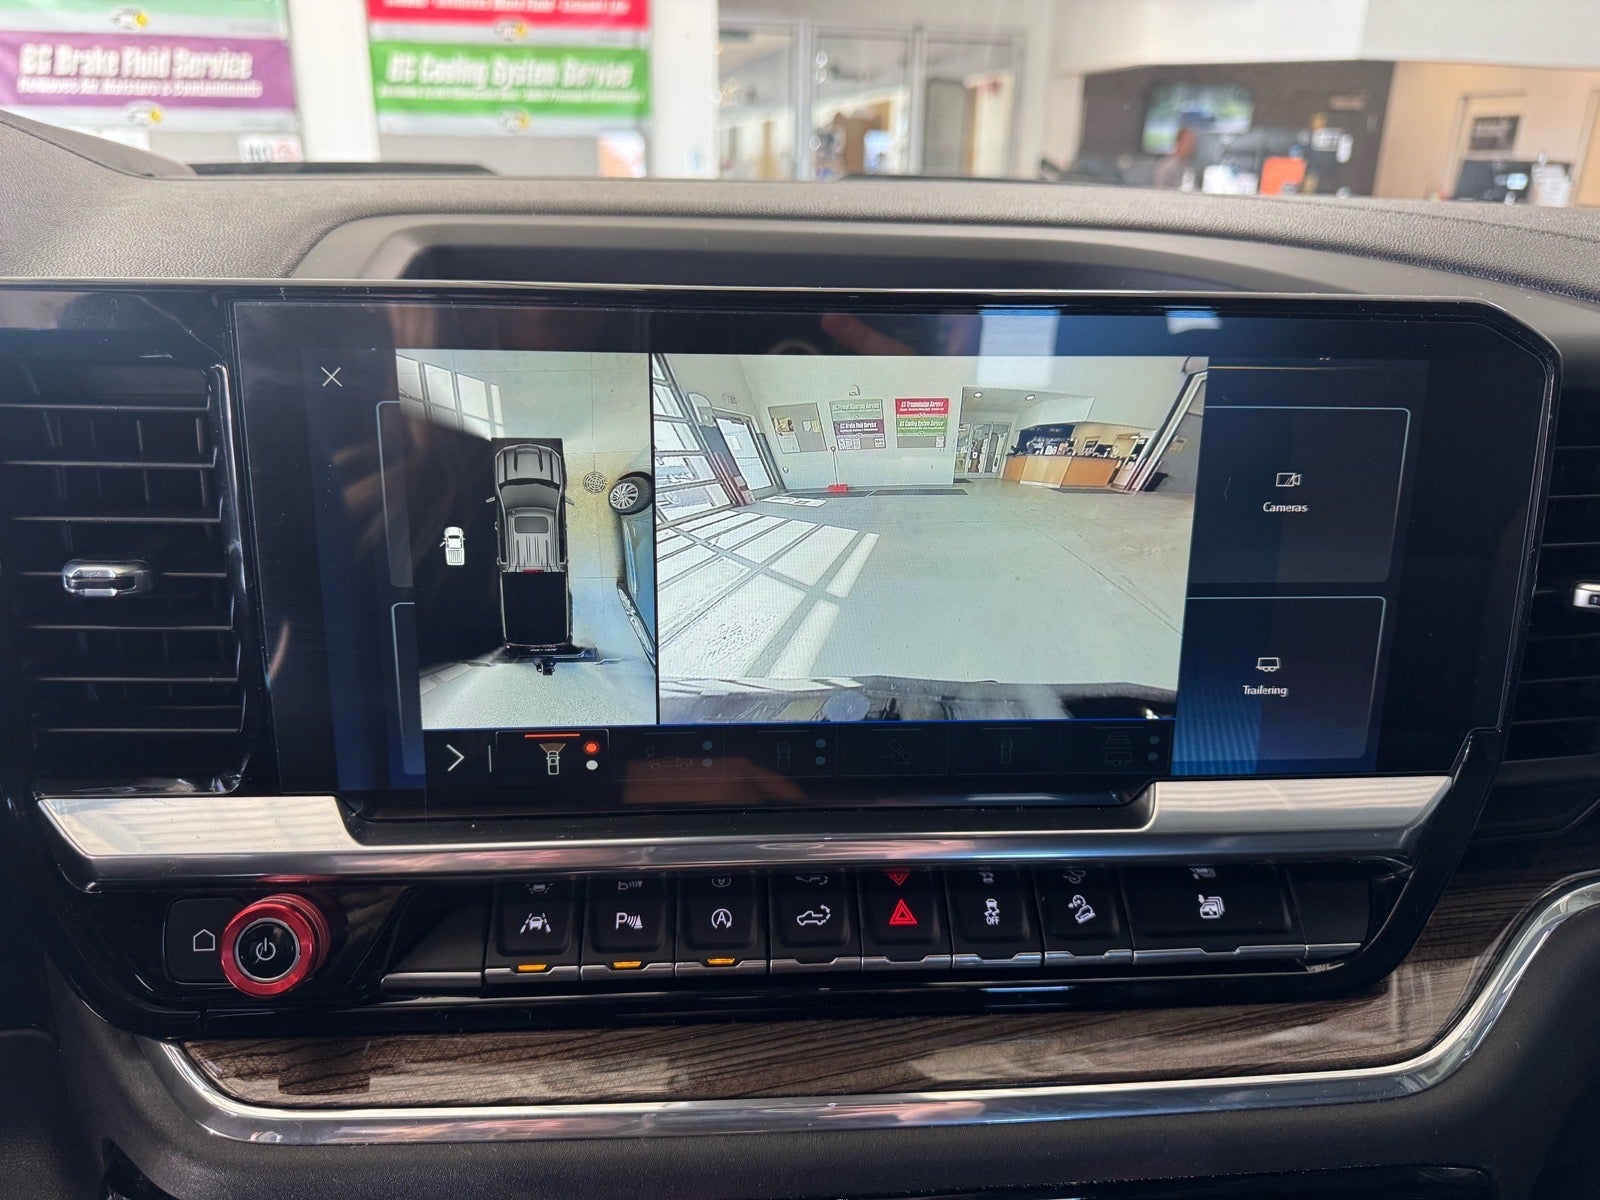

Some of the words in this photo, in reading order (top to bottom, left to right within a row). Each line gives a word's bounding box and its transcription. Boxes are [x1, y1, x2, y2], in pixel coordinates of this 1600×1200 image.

[172, 46, 253, 80] Service
[1263, 502, 1308, 513] Cameras
[1242, 685, 1288, 698] Trailering
[986, 916, 1000, 926] OFF
